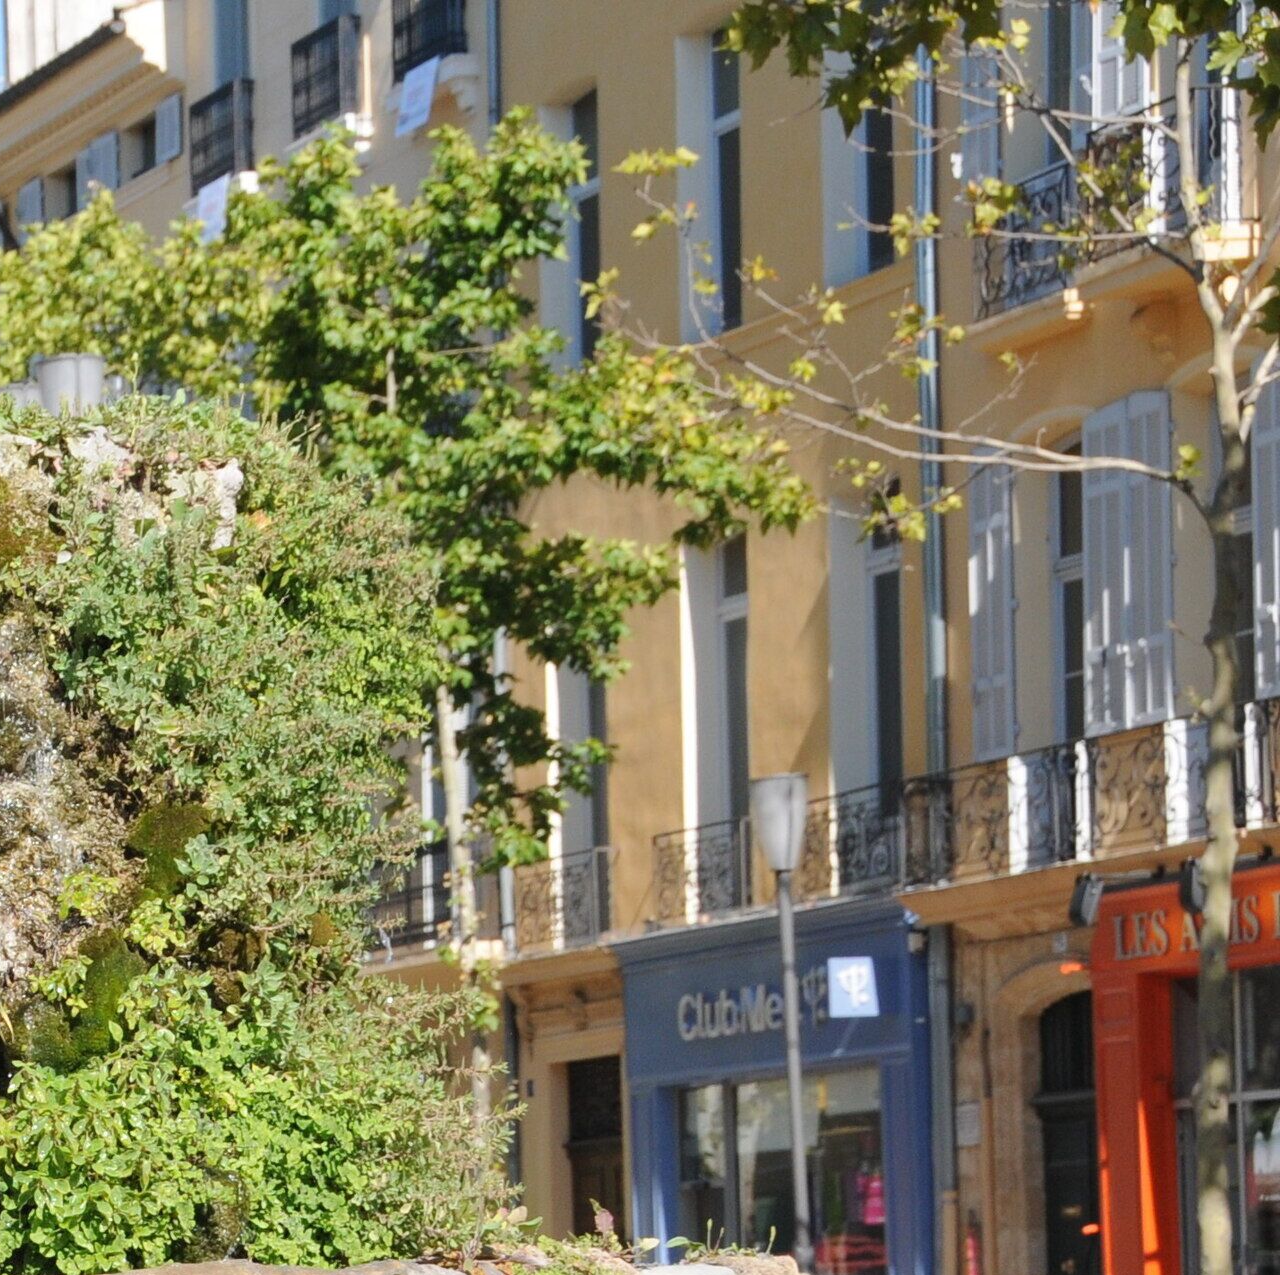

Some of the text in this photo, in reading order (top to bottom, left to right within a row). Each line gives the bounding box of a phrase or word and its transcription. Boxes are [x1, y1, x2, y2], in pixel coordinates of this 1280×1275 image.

[1114, 909, 1169, 960] LES
[1179, 895, 1261, 952] AIS
[678, 989, 739, 1041] Club
